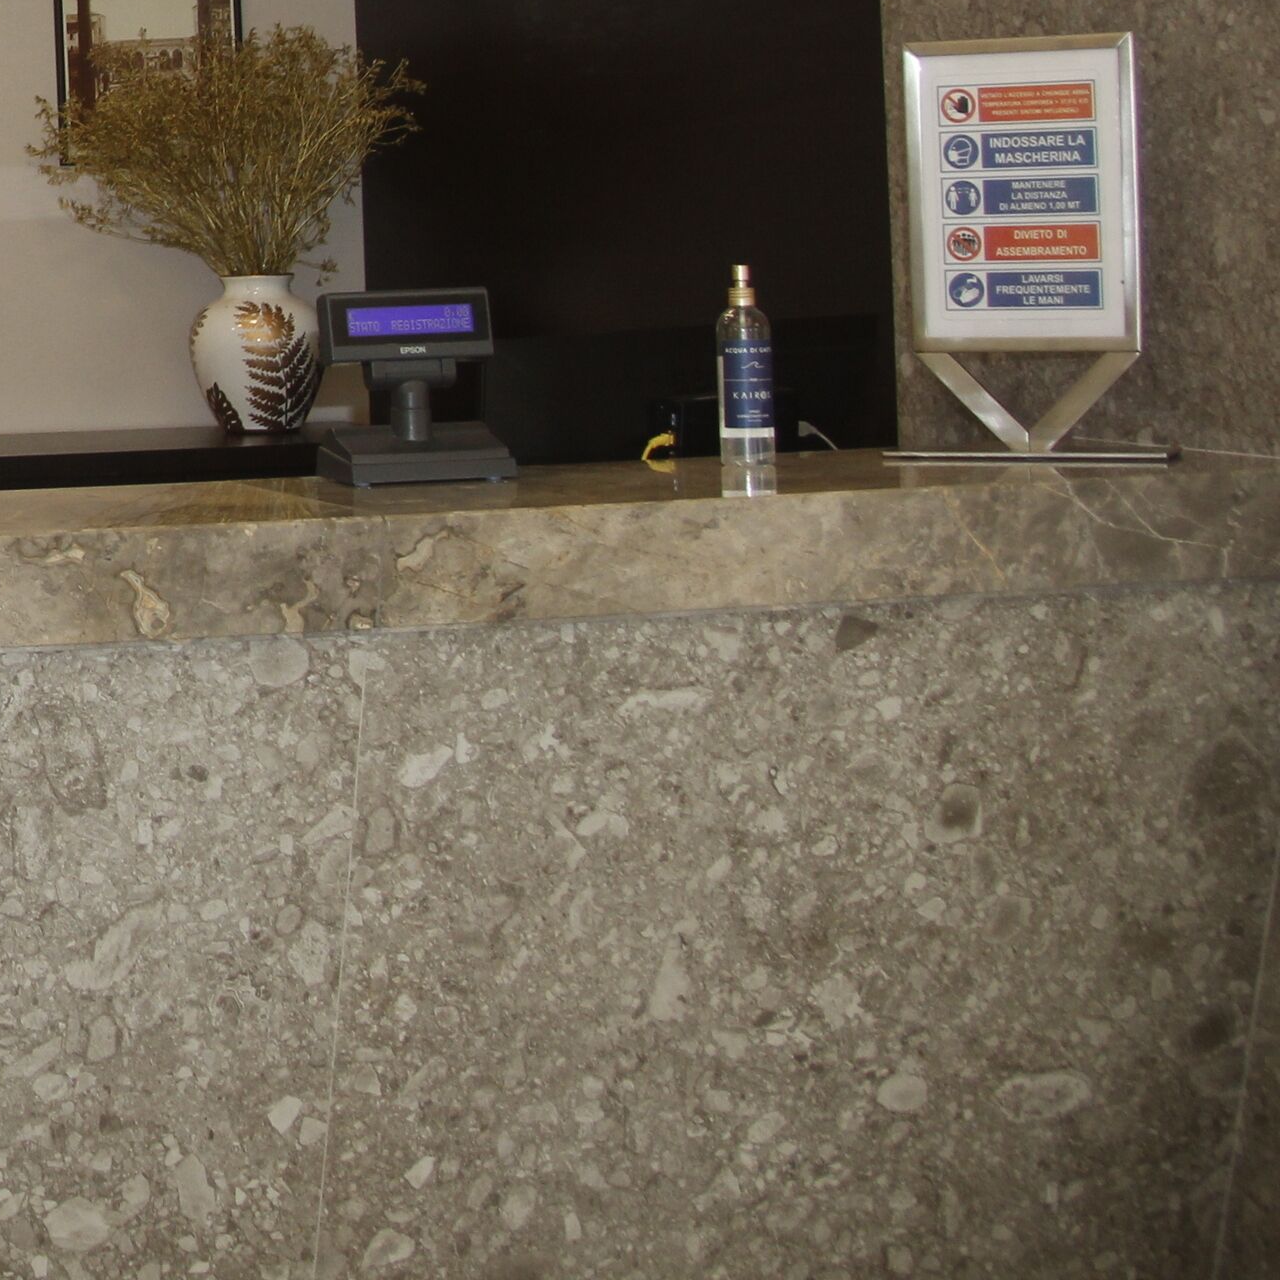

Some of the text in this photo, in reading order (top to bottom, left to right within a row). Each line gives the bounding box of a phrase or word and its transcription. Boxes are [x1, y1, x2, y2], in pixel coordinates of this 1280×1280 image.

[989, 134, 1086, 148] INDOSSARE LA
[995, 150, 1081, 164] MASCHERINA
[1011, 180, 1066, 189] MANTENERE
[1011, 191, 1068, 200] LA DISTANZA
[999, 202, 1009, 211] DI
[1010, 202, 1047, 210] ALMENO
[1067, 200, 1080, 209] MT
[1014, 229, 1068, 239] DIVIETO DI
[996, 246, 1087, 256] ASSEMBRAMENTO
[1021, 274, 1064, 283] LAVARSI
[996, 284, 1090, 294] FREQUENTEMENTE
[1023, 296, 1064, 305] LE MANI
[349, 321, 380, 333] STATO
[400, 345, 426, 355] EPSON
